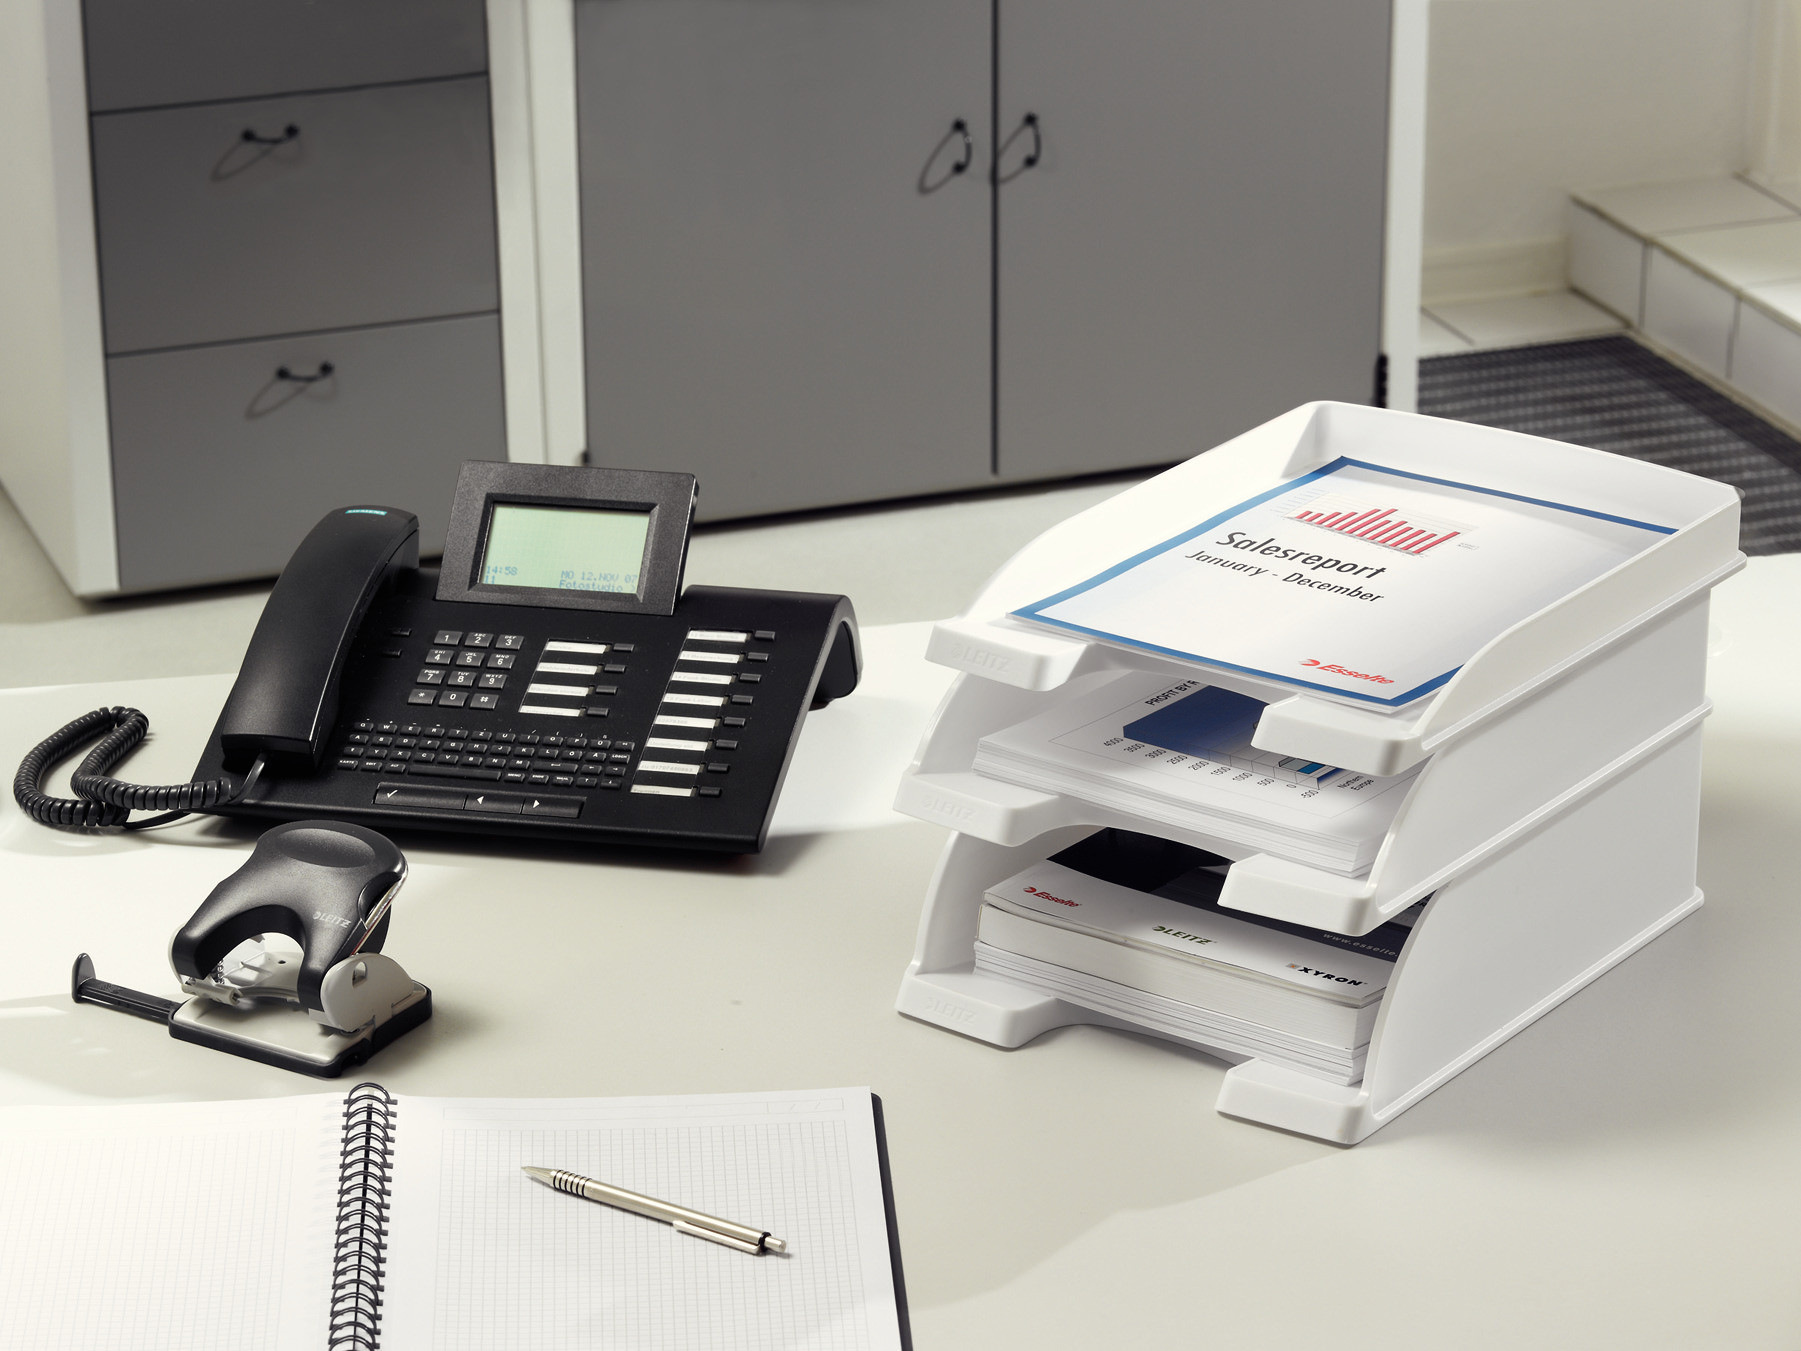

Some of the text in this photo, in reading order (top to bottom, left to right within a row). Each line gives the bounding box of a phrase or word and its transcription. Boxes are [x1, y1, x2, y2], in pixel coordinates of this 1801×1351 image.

[1216, 531, 1387, 579] Salesreport
[486, 565, 518, 576] 14:58
[561, 570, 574, 580] MO
[624, 574, 638, 583] 07
[1185, 550, 1268, 577] January
[1282, 572, 1385, 602] December
[559, 579, 623, 592] Fotostudio
[445, 634, 449, 642] 1
[466, 655, 472, 663] 5
[1316, 664, 1395, 684] Esselte
[489, 677, 495, 685] 9
[1144, 689, 1179, 706] PROFIT
[1174, 682, 1192, 695] BY
[1103, 736, 1124, 747] 4000
[1123, 742, 1146, 753] 3500
[1144, 748, 1167, 759] 3000
[1166, 754, 1189, 765] 2500
[1187, 760, 1210, 771] 2000
[1210, 766, 1231, 776] 1500
[1232, 772, 1253, 782] 1000
[1257, 778, 1275, 786] 500
[1337, 775, 1364, 789] Northern
[1350, 779, 1374, 791] Europe
[1033, 891, 1079, 907] Esselte
[320, 912, 351, 928] LEITZ
[1164, 927, 1212, 945] LEITZ
[1299, 966, 1363, 987] XYRON
